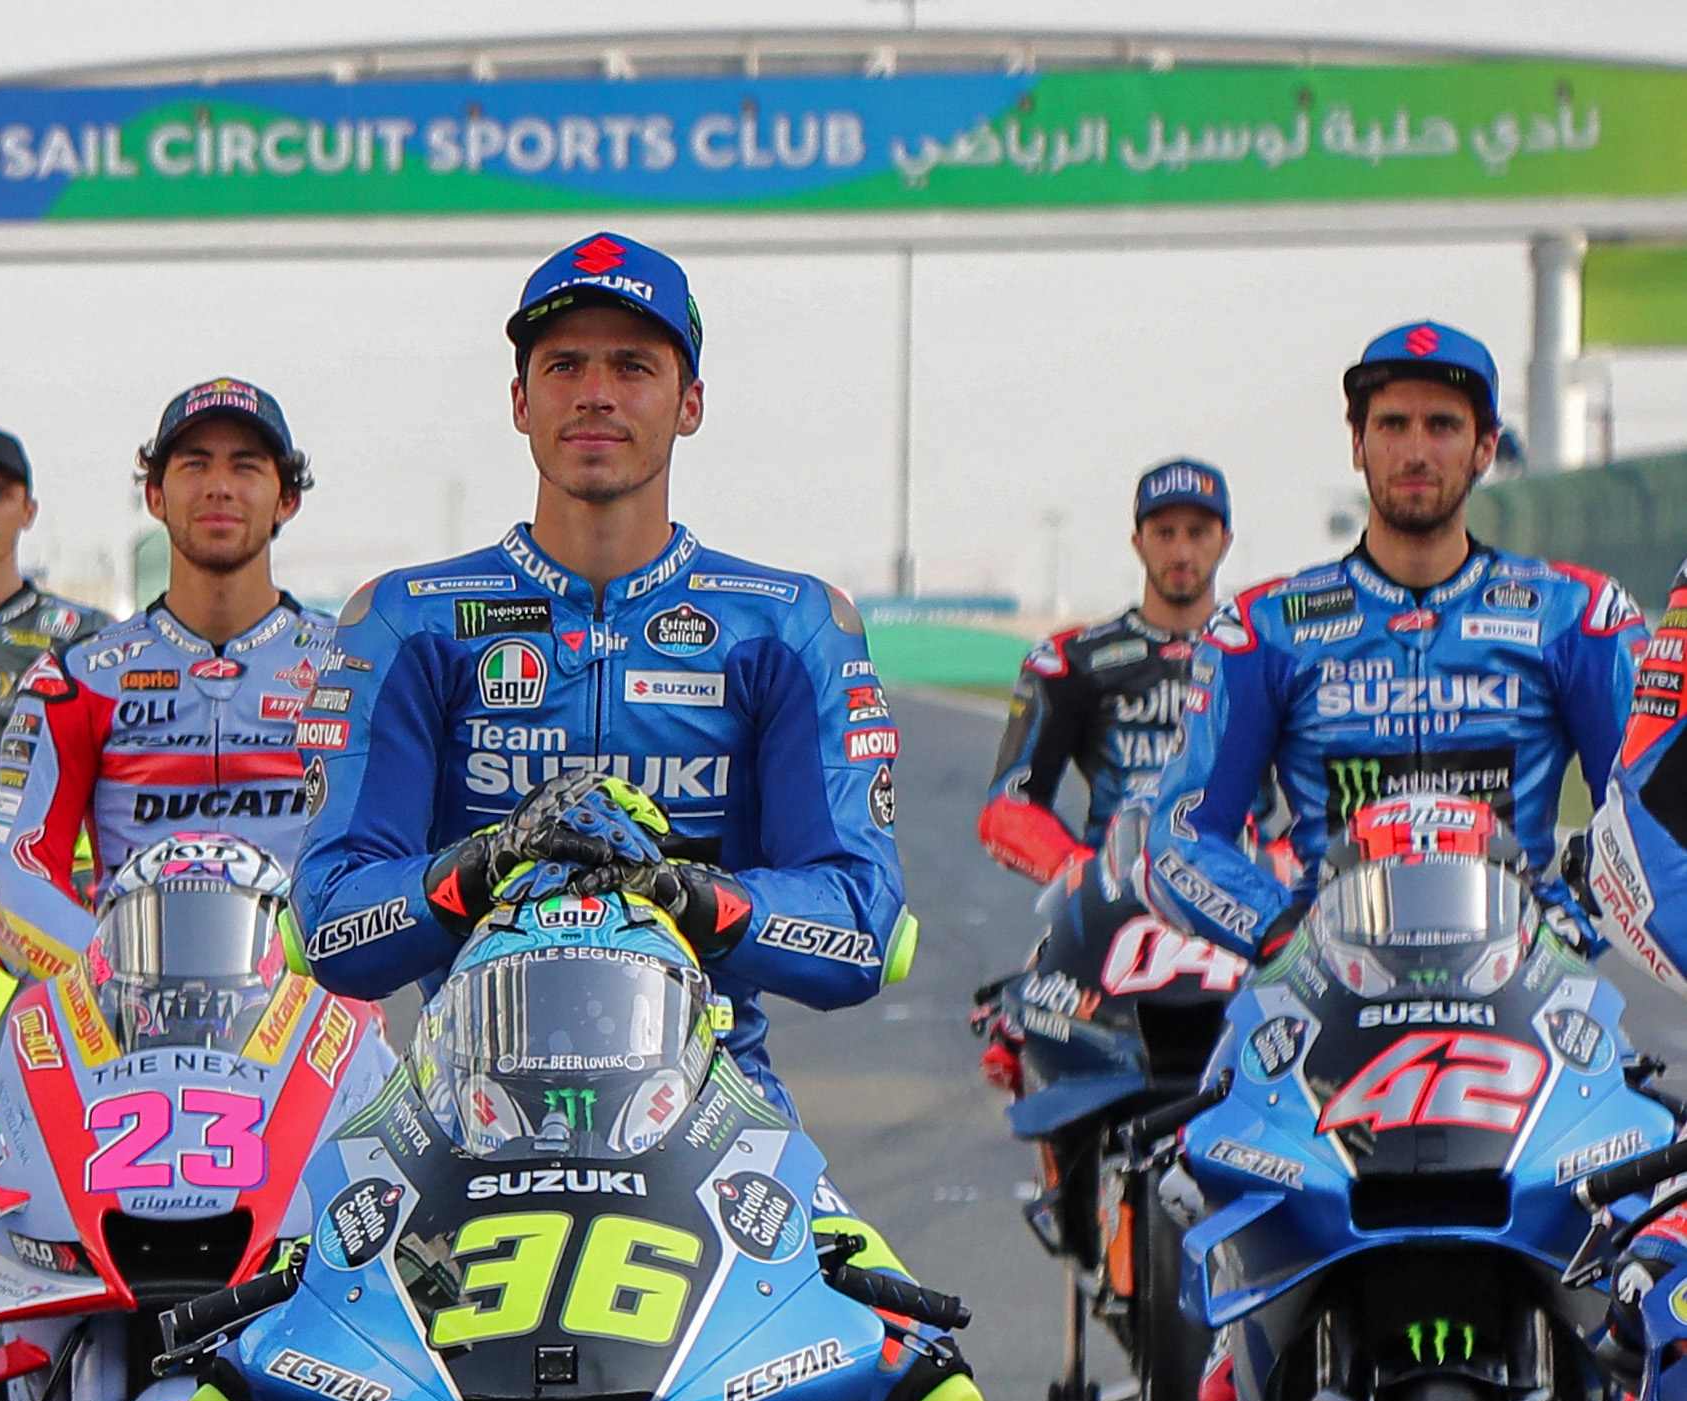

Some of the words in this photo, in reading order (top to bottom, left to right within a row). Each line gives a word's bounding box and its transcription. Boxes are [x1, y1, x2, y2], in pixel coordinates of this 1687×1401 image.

[147, 116, 415, 176] CIRCUIT
[429, 113, 674, 173] SPORTS
[692, 111, 867, 171] CLUB
[658, 631, 703, 645] Galicia
[659, 616, 707, 633] Estrella
[86, 640, 154, 672] KYT
[1316, 660, 1394, 684] Team
[489, 682, 536, 705] agv
[652, 682, 717, 696] SUZUKI
[1316, 675, 1521, 717] SUZUKI
[296, 721, 343, 747] MOTUL
[465, 719, 567, 752] Team
[1374, 715, 1461, 737] MotoGP
[1387, 768, 1510, 796] MONSTER
[133, 787, 308, 824] DUCATI
[1601, 829, 1649, 917] GENERAC
[1154, 850, 1259, 944] ECSTAR
[543, 907, 600, 929] agv
[1592, 875, 1674, 984] PRAMAC
[756, 912, 882, 968] ECSTAR
[495, 948, 561, 970] REALE
[562, 946, 664, 970] SEGUROS
[1358, 1003, 1497, 1030] SUZUKI
[91, 1053, 161, 1086] THE
[174, 1050, 270, 1086] NEXT
[1315, 1030, 1548, 1136] 42
[84, 1085, 269, 1193] 23
[685, 1092, 730, 1152] MONSTER
[466, 1169, 648, 1200] SUZUKI
[333, 1202, 365, 1257] Galicia
[353, 1184, 387, 1244] Estrella
[728, 1179, 769, 1244] Estrella
[749, 1194, 790, 1248] Galicia
[425, 1210, 705, 1347] 36
